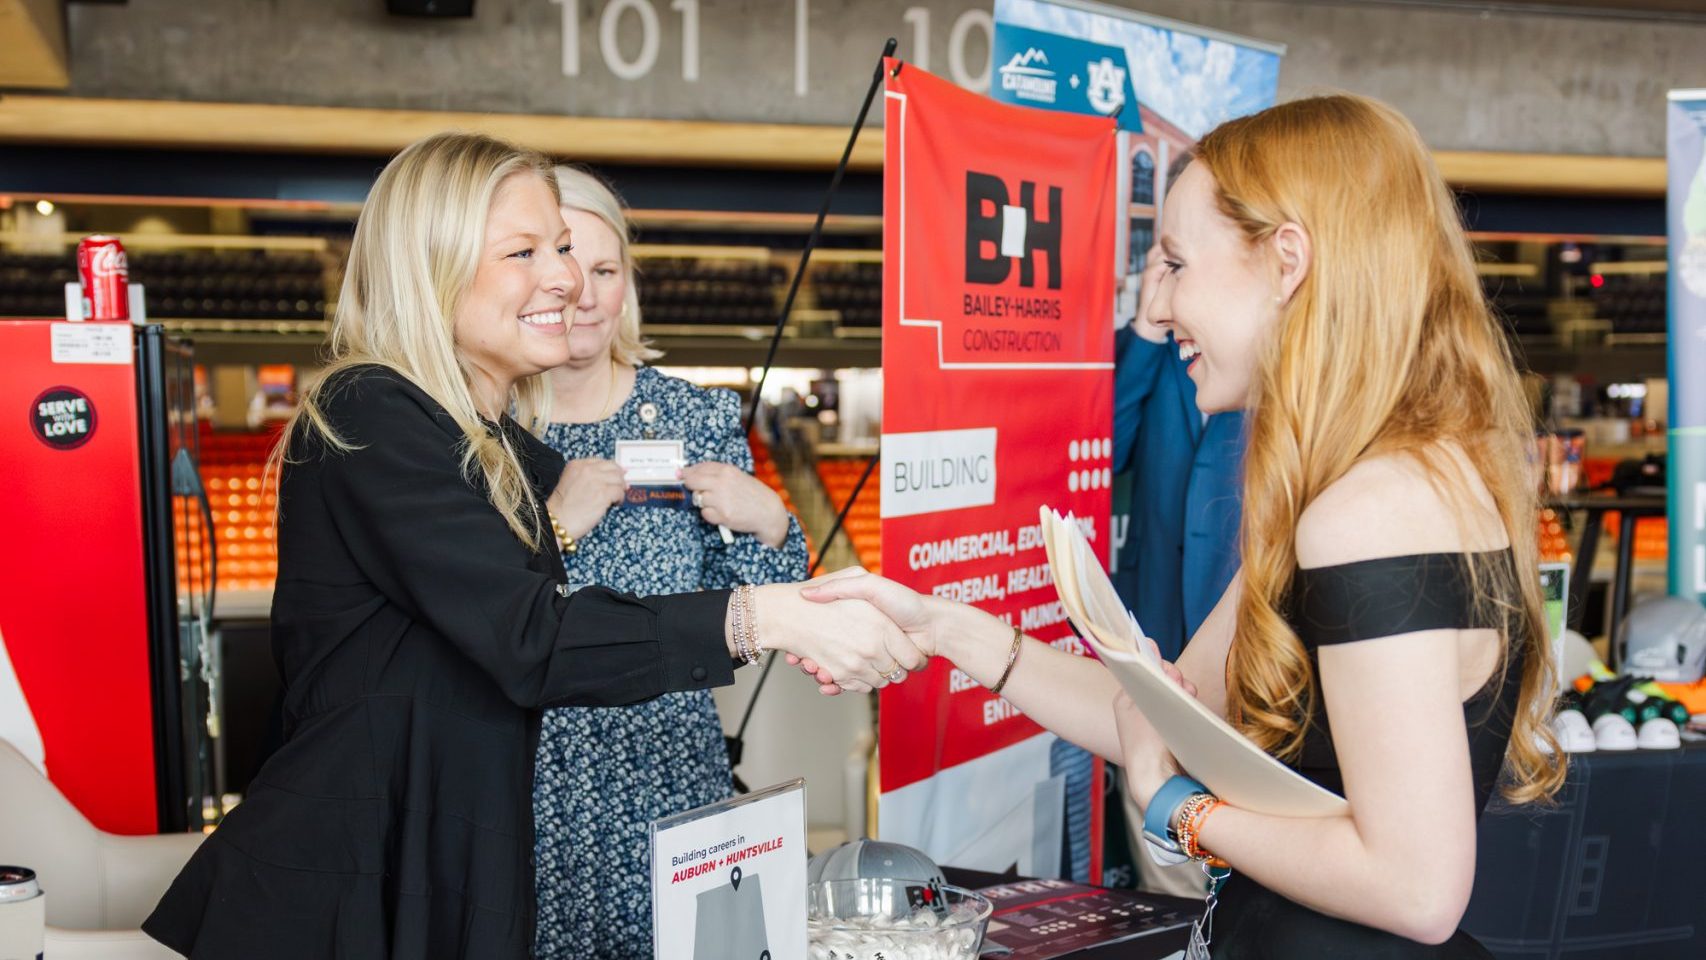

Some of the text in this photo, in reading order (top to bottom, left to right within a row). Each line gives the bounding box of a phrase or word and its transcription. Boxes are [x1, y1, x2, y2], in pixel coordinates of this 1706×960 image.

[549, 0, 698, 80] 101
[904, 8, 993, 91] 10
[965, 170, 1063, 290] BH
[963, 294, 1062, 320] BAILEY-HARRIS
[963, 328, 1062, 352] CONSTRUCTION
[38, 398, 87, 416] SERVE
[44, 418, 87, 437] LOVE
[894, 455, 988, 493] BUILDING
[908, 529, 1015, 571] COMMERCIAL,
[932, 573, 1006, 603] FEDERAL,
[671, 860, 716, 884] AUBURN
[726, 836, 784, 866] HUNTSVILLE
[672, 834, 745, 867] Building careers in
